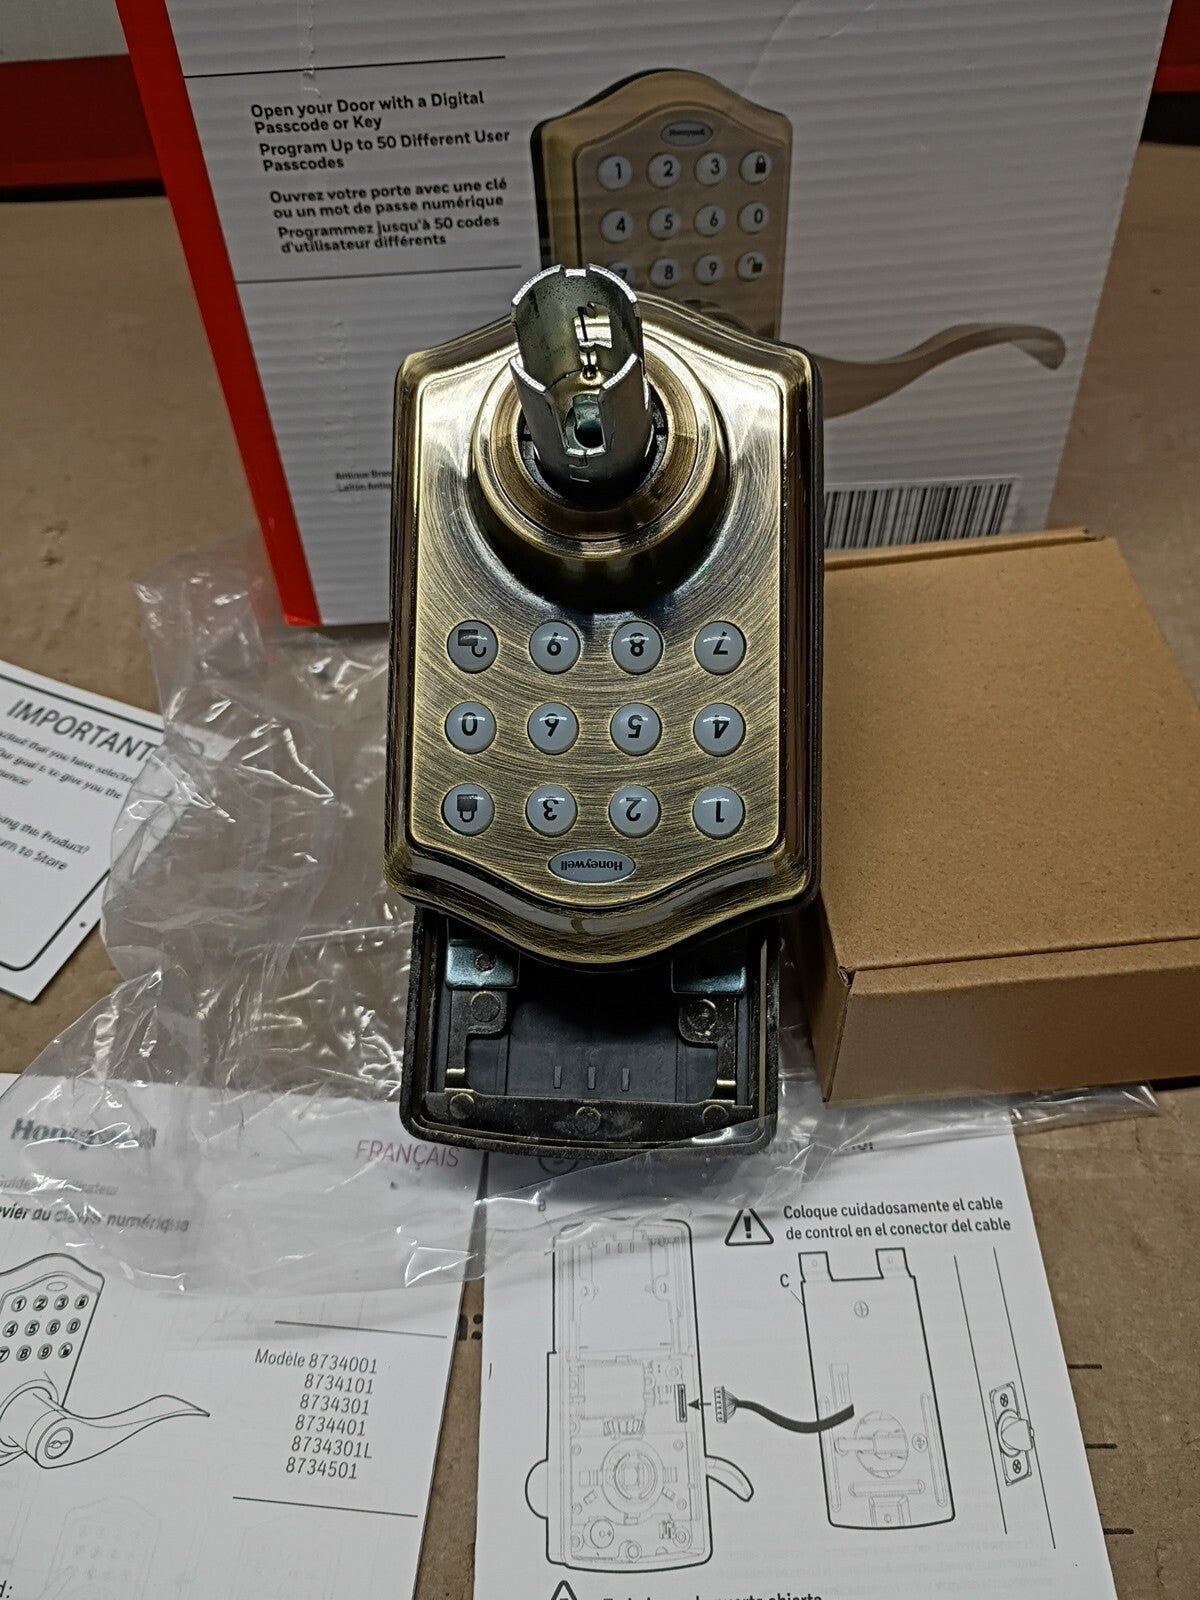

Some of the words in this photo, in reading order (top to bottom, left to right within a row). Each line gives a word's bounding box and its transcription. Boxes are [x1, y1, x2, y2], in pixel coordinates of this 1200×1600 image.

[251, 104, 294, 119] Open
[297, 103, 333, 118] your
[337, 99, 375, 112] Door
[379, 95, 414, 110] with
[418, 97, 427, 108] a
[431, 91, 485, 109] Digital
[255, 119, 329, 134] Passcode
[333, 119, 349, 130] or
[353, 115, 382, 131] Key
[260, 142, 327, 158] Program
[331, 139, 353, 154] Up
[357, 138, 373, 150] to
[377, 136, 397, 149] 50
[400, 132, 471, 148] Different
[474, 130, 510, 143] User
[263, 157, 344, 172] Passcodes
[614, 162, 623, 179] 1
[663, 160, 673, 178] 2
[710, 158, 720, 175] 3
[270, 191, 324, 203] Ouvrez
[327, 188, 367, 200] votre
[371, 185, 411, 200] porte
[415, 184, 450, 195] avec
[453, 182, 481, 193] une
[485, 177, 507, 191] clé
[273, 208, 292, 219] ou
[296, 207, 316, 217] un
[319, 204, 350, 216] mot
[353, 202, 371, 214] de
[376, 201, 418, 215] passe
[422, 195, 504, 210] numérique
[754, 209, 763, 224] 0
[278, 224, 374, 240] Programmez
[377, 220, 431, 235] jusqu'à
[434, 217, 453, 229] 50
[456, 215, 500, 228] codes
[616, 217, 626, 233] 4
[663, 214, 673, 230] 5
[709, 211, 718, 227] 6
[281, 239, 370, 253] d'utilisateur
[374, 234, 447, 248] différents
[664, 265, 673, 280] 8
[709, 262, 718, 277] 9
[630, 632, 645, 657] 8
[713, 631, 728, 655] 7
[6, 699, 159, 763] IMPORTANT
[462, 712, 477, 737] 0
[628, 714, 643, 739] 5
[712, 714, 730, 739] 4
[48, 749, 69, 761] you
[70, 756, 96, 770] have
[59, 773, 84, 786] give
[81, 781, 104, 793] you
[105, 788, 122, 799] the
[543, 797, 559, 821] 3
[626, 797, 643, 822] 2
[715, 798, 726, 823] 1
[41, 830, 90, 855] Product?
[19, 845, 33, 857] to
[34, 850, 68, 870] Store
[560, 858, 623, 871] Honeywell
[355, 1140, 460, 1170] FRANÇAIS
[0, 1202, 30, 1221] vier
[32, 1205, 51, 1221] du
[783, 1205, 838, 1221] Coloque
[840, 1200, 949, 1217] cuidadosamente
[953, 1198, 965, 1211] el
[967, 1197, 1003, 1211] cable
[785, 1227, 802, 1240] de
[805, 1224, 851, 1239] control
[855, 1225, 872, 1237] en
[875, 1222, 887, 1236] el
[890, 1220, 948, 1235] conector
[951, 1218, 972, 1233] del
[975, 1217, 1011, 1232] cable
[779, 1273, 790, 1288] C
[16, 1299, 23, 1309] 1
[35, 1299, 45, 1310] 2
[57, 1298, 66, 1308] 3
[6, 1323, 16, 1334] 4
[28, 1323, 37, 1334] 5
[49, 1323, 58, 1332] 6
[70, 1321, 78, 1331] 0
[20, 1348, 29, 1359] 8
[41, 1347, 50, 1357] 9
[255, 1348, 305, 1368] Modèle
[309, 1353, 377, 1374] 8734001
[304, 1373, 374, 1395] 8734101
[300, 1393, 369, 1416] 8734301
[295, 1414, 365, 1437] 8734401
[291, 1435, 372, 1459] 8734301L
[286, 1457, 357, 1480] 8734501
